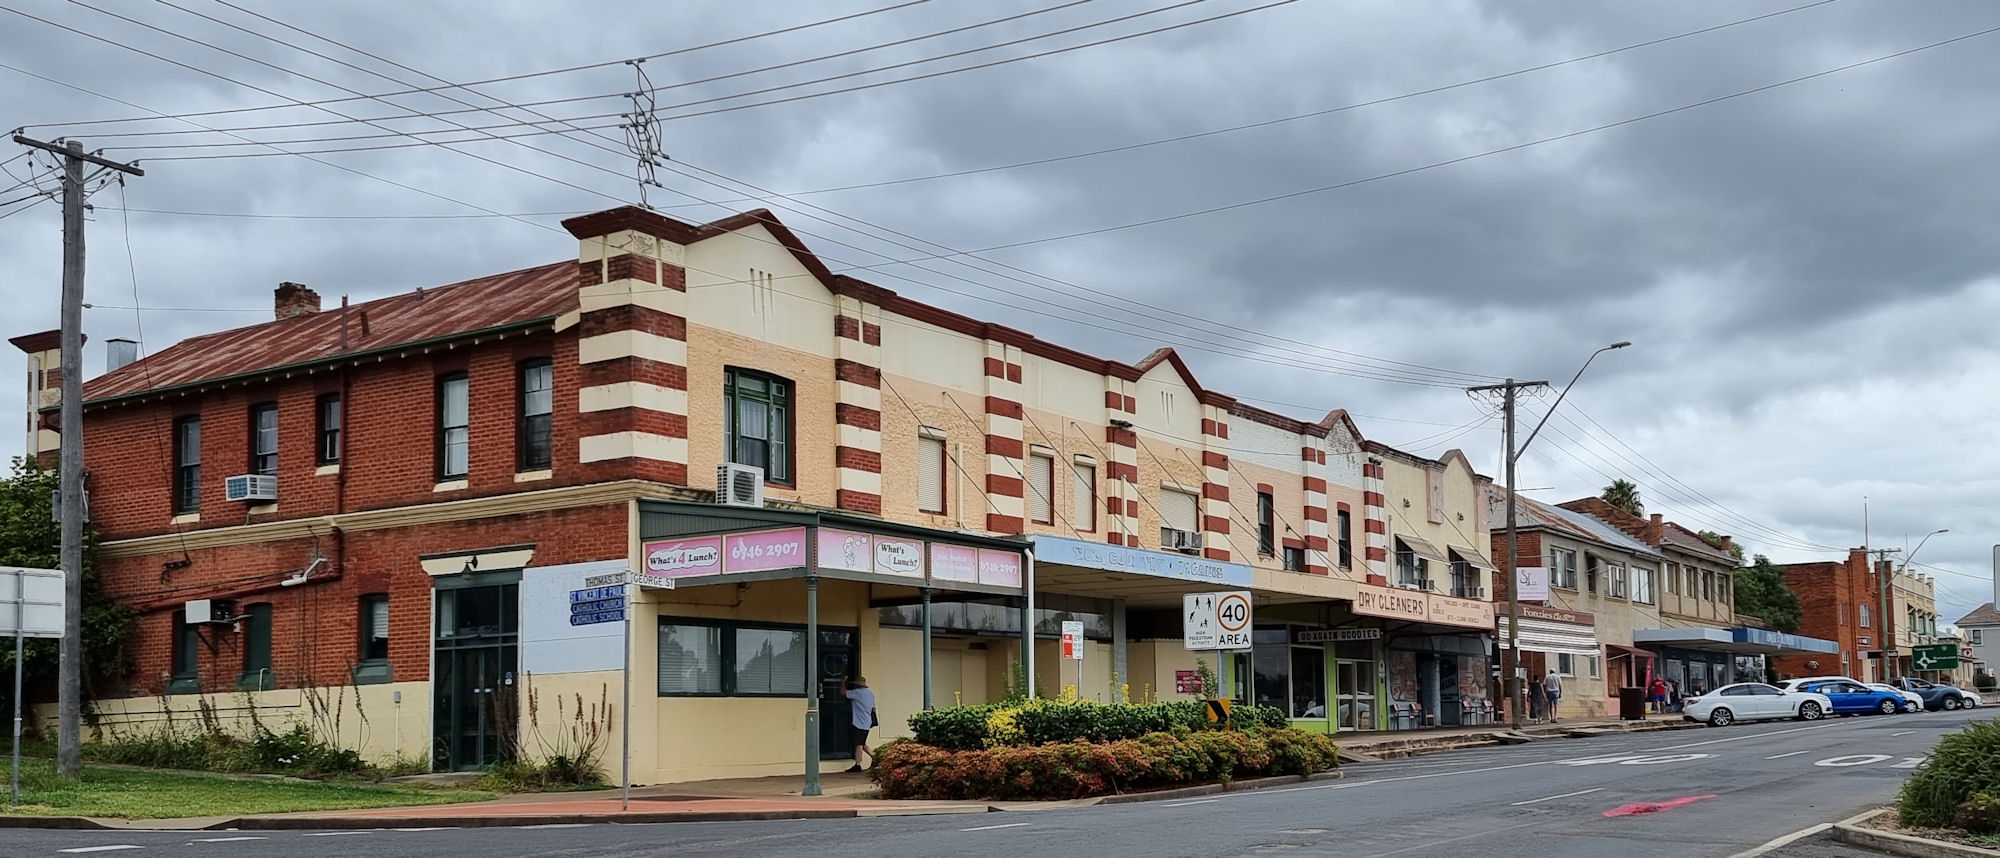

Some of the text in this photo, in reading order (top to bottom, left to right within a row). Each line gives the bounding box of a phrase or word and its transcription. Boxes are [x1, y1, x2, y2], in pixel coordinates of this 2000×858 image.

[767, 543, 798, 556] 2907
[881, 544, 904, 554] What's
[649, 552, 717, 566] What's 4 Lunch?
[893, 557, 917, 567] Lunch?
[586, 575, 623, 587] THOMAS ST
[633, 574, 674, 588] GEORGE ST
[578, 588, 599, 601] VINCENT
[600, 588, 608, 598] DE
[600, 599, 623, 609] CHURCH
[1359, 592, 1376, 608] DRY
[1379, 595, 1423, 615] CLEANERS
[599, 611, 623, 622] SCHOOL
[1222, 604, 1245, 622] 40
[1523, 607, 1552, 618] Fonzies
[1219, 634, 1249, 645] AREA
[1301, 630, 1377, 640] GO AGAIN GOODIES
